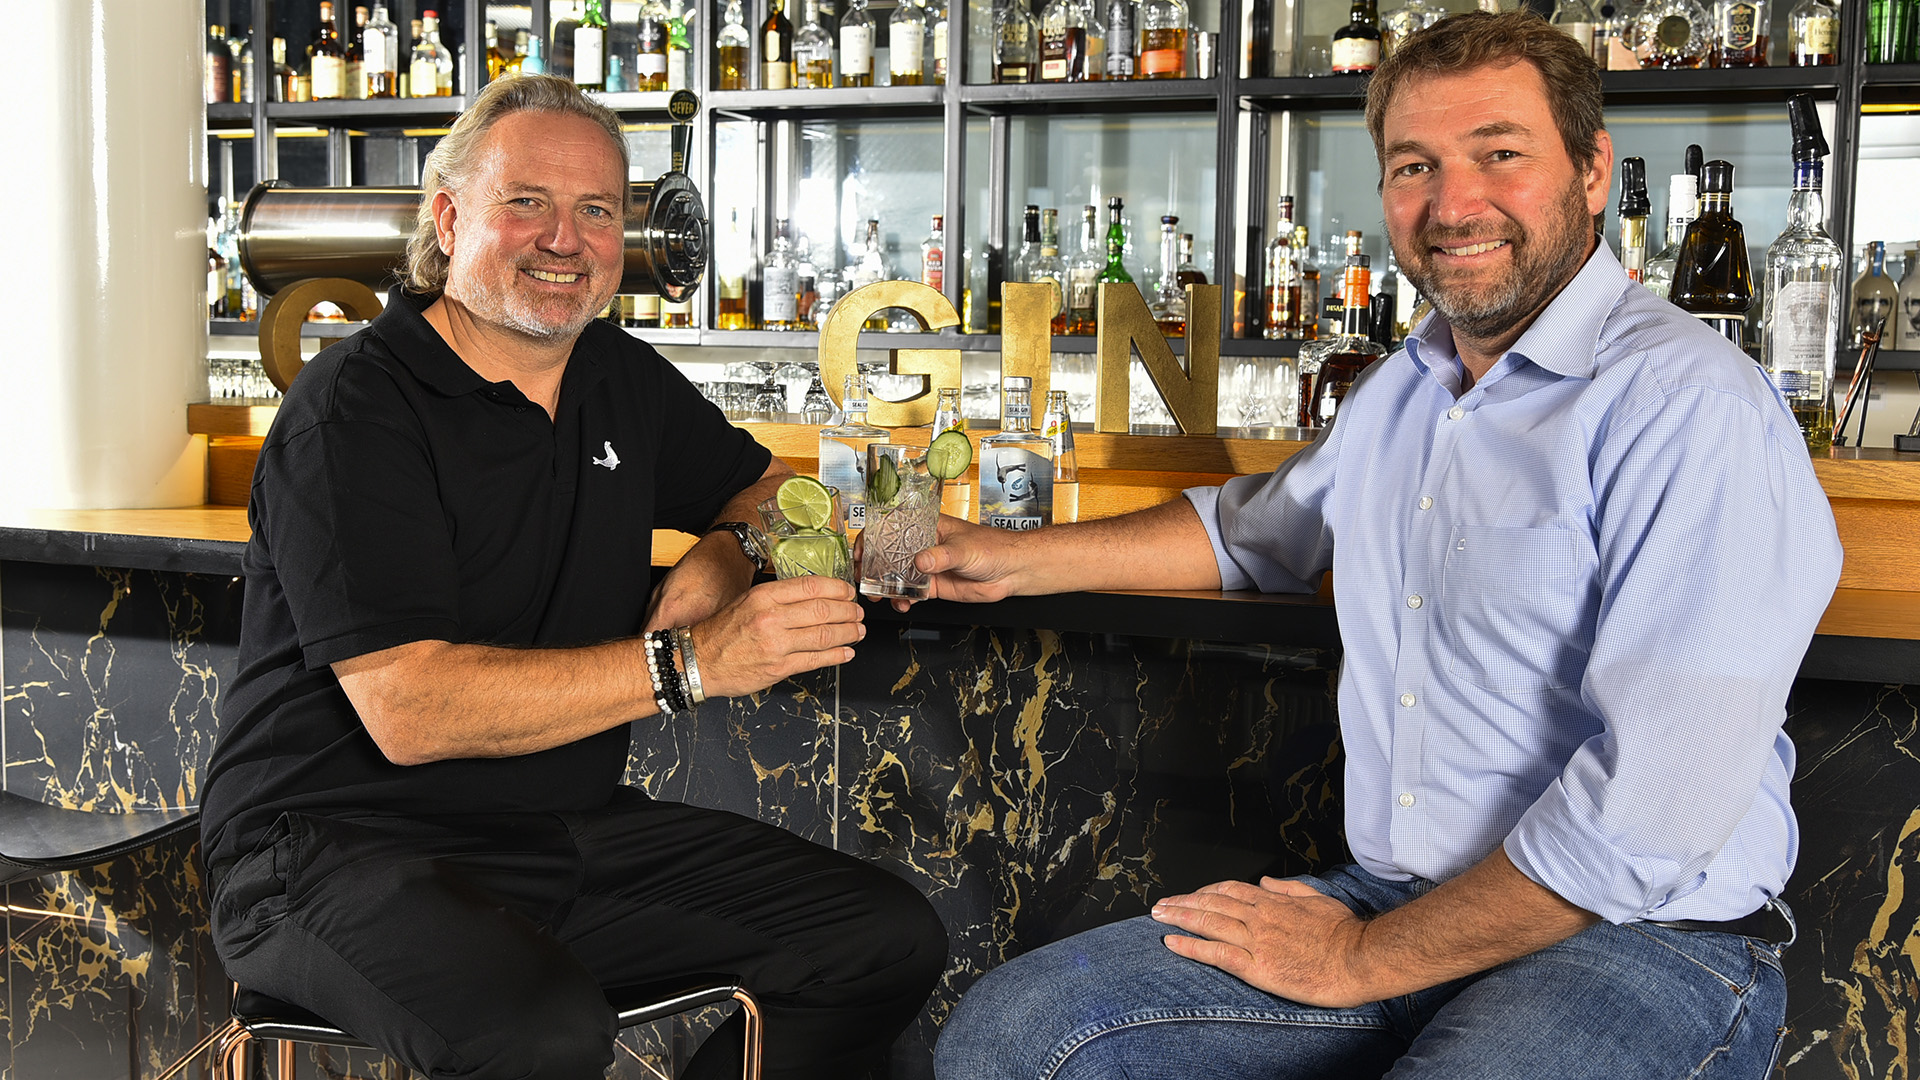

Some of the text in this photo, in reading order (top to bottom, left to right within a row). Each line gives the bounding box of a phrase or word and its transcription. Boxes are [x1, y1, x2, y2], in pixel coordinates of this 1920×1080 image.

[672, 101, 694, 114] JEVER
[673, 151, 683, 172] EVER
[818, 280, 1222, 435] GIN
[852, 506, 865, 518] SE
[994, 518, 1039, 530] SEAL GIN
